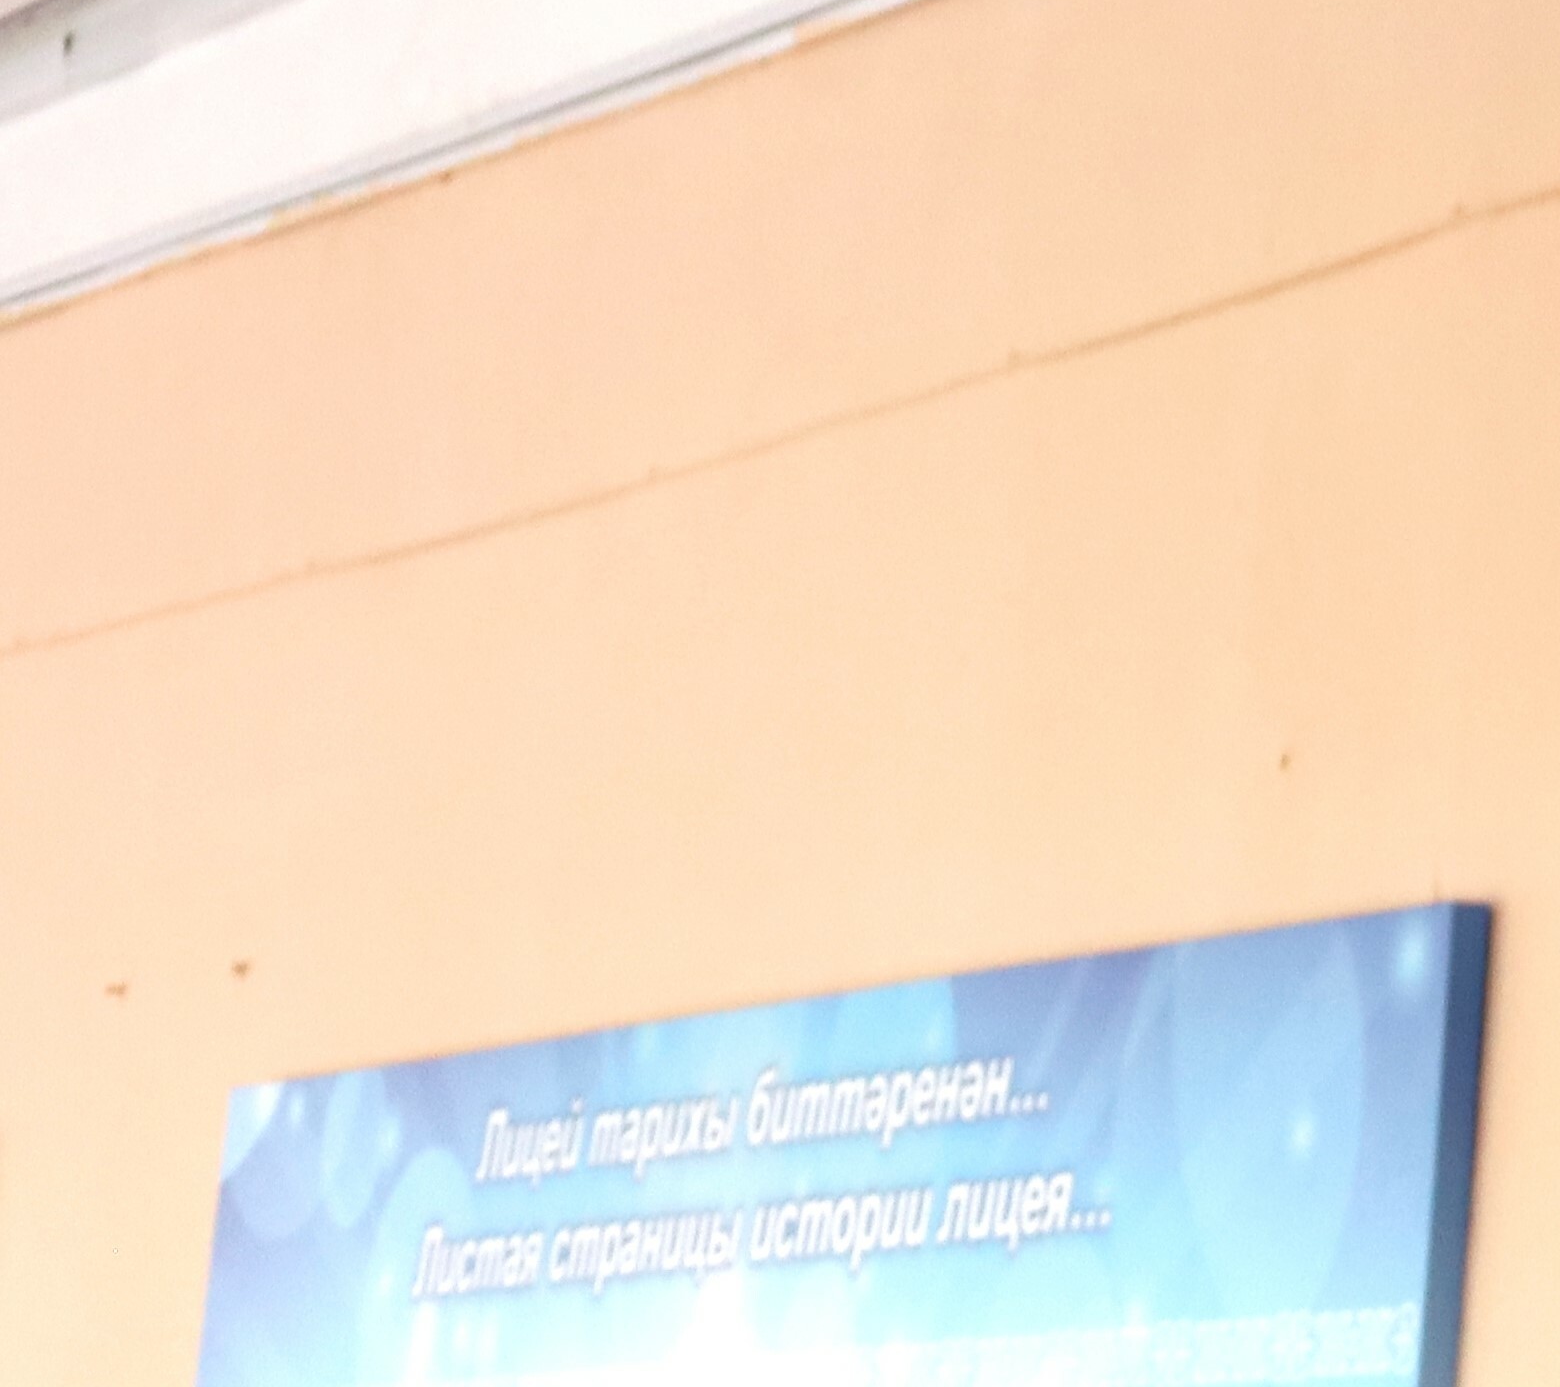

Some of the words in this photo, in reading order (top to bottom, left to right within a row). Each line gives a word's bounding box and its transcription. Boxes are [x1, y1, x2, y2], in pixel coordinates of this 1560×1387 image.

[475, 1096, 585, 1187] Лицей
[588, 1089, 741, 1181] тарихы
[411, 1223, 545, 1299] Листая
[549, 1208, 744, 1297] страницы
[749, 1187, 933, 1273] истории
[936, 1169, 1113, 1252] лицея...
